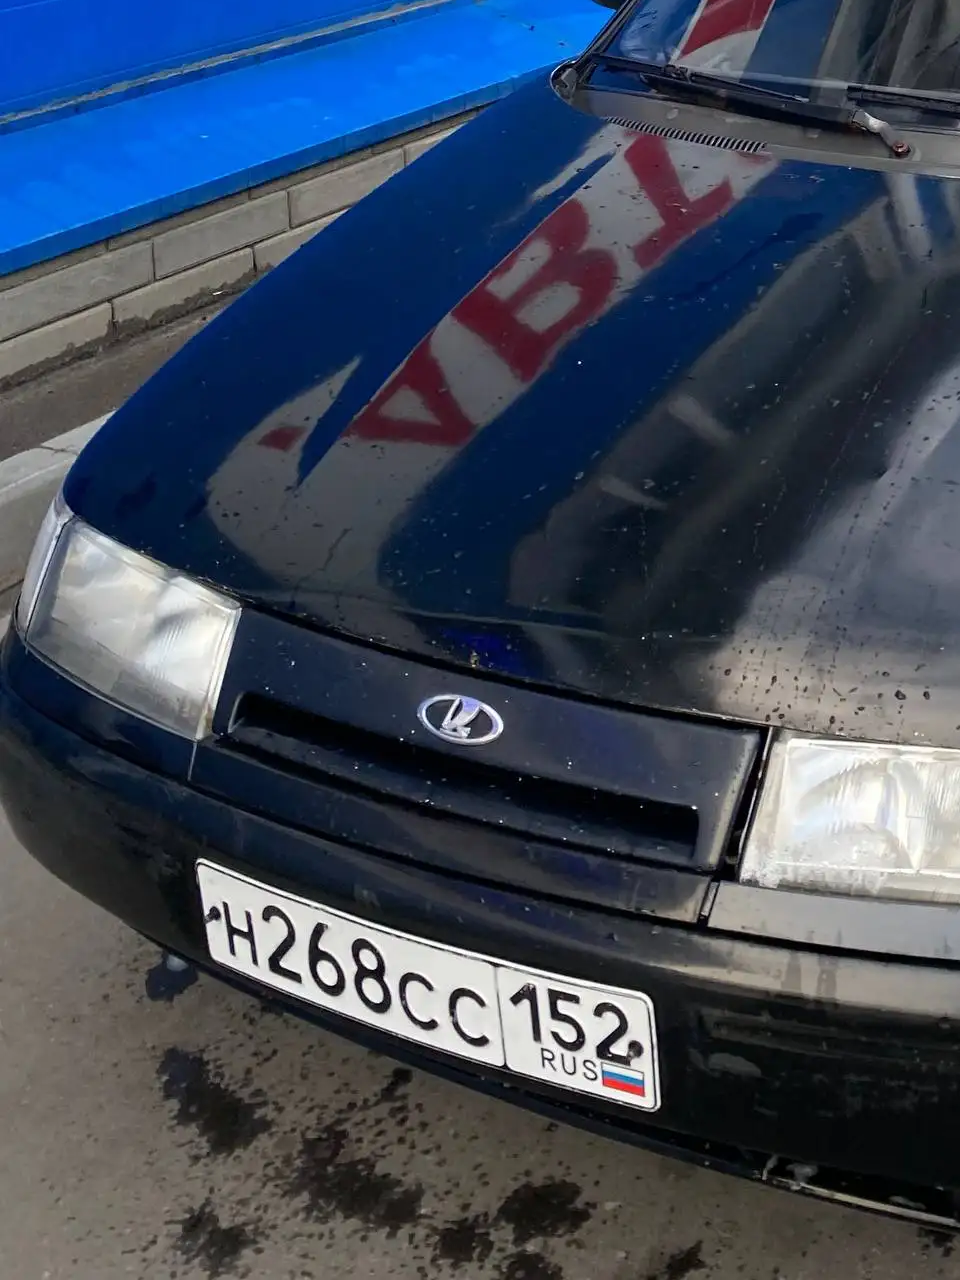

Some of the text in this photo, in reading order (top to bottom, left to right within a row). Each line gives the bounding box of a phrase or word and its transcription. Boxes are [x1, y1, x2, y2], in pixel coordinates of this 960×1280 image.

[222, 901, 631, 1066] Н268СС 152
[540, 1047, 598, 1081] RUS
